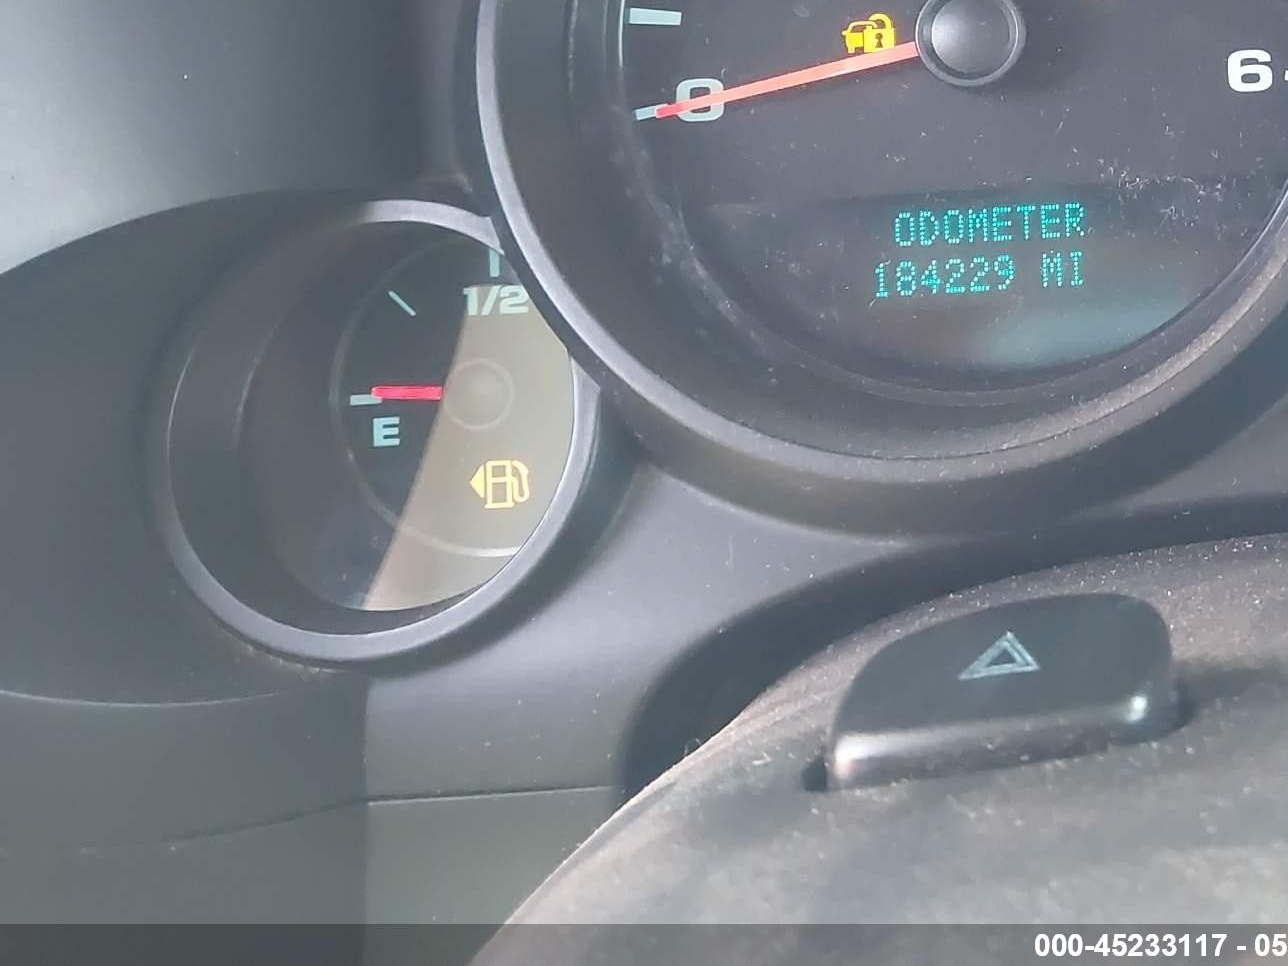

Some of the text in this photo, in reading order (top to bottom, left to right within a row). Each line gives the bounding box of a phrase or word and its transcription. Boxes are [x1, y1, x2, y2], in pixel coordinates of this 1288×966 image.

[1226, 50, 1273, 93] 6
[675, 78, 725, 122] 0
[894, 202, 1087, 247] ODOMETER
[873, 250, 1085, 298] 184229 MI
[463, 286, 529, 316] 1/2
[372, 416, 400, 447] E
